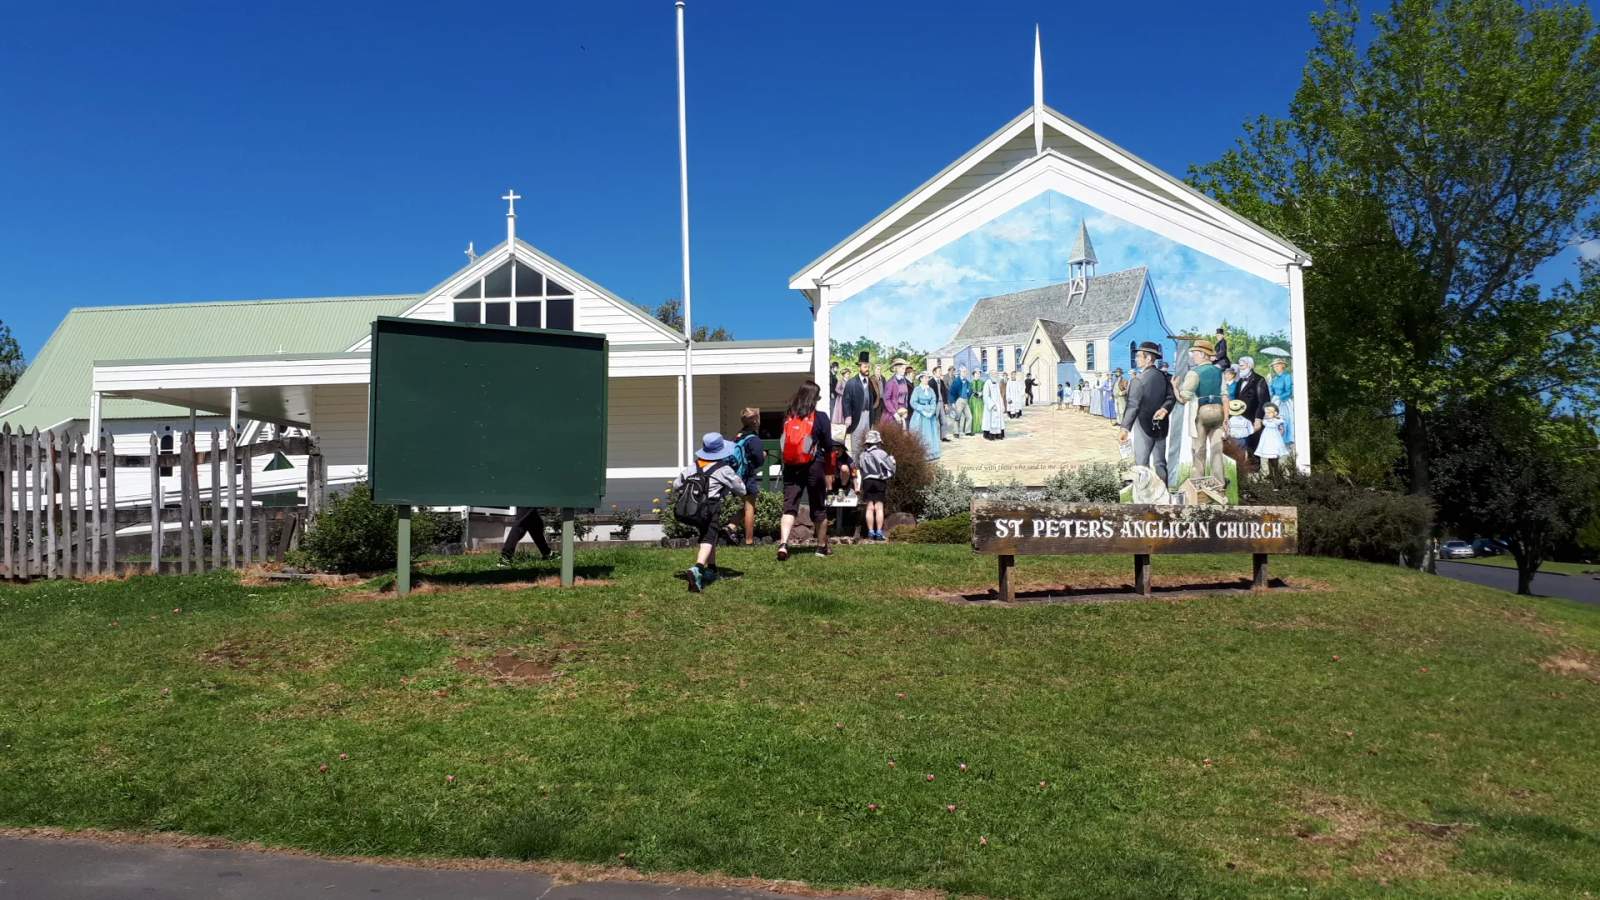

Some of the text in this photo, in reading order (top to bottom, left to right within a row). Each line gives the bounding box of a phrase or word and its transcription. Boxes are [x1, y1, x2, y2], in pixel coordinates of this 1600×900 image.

[1032, 517, 1114, 538] PETER'S
[1120, 519, 1210, 538] ANGLICAN
[1216, 521, 1281, 539] CHURCH
